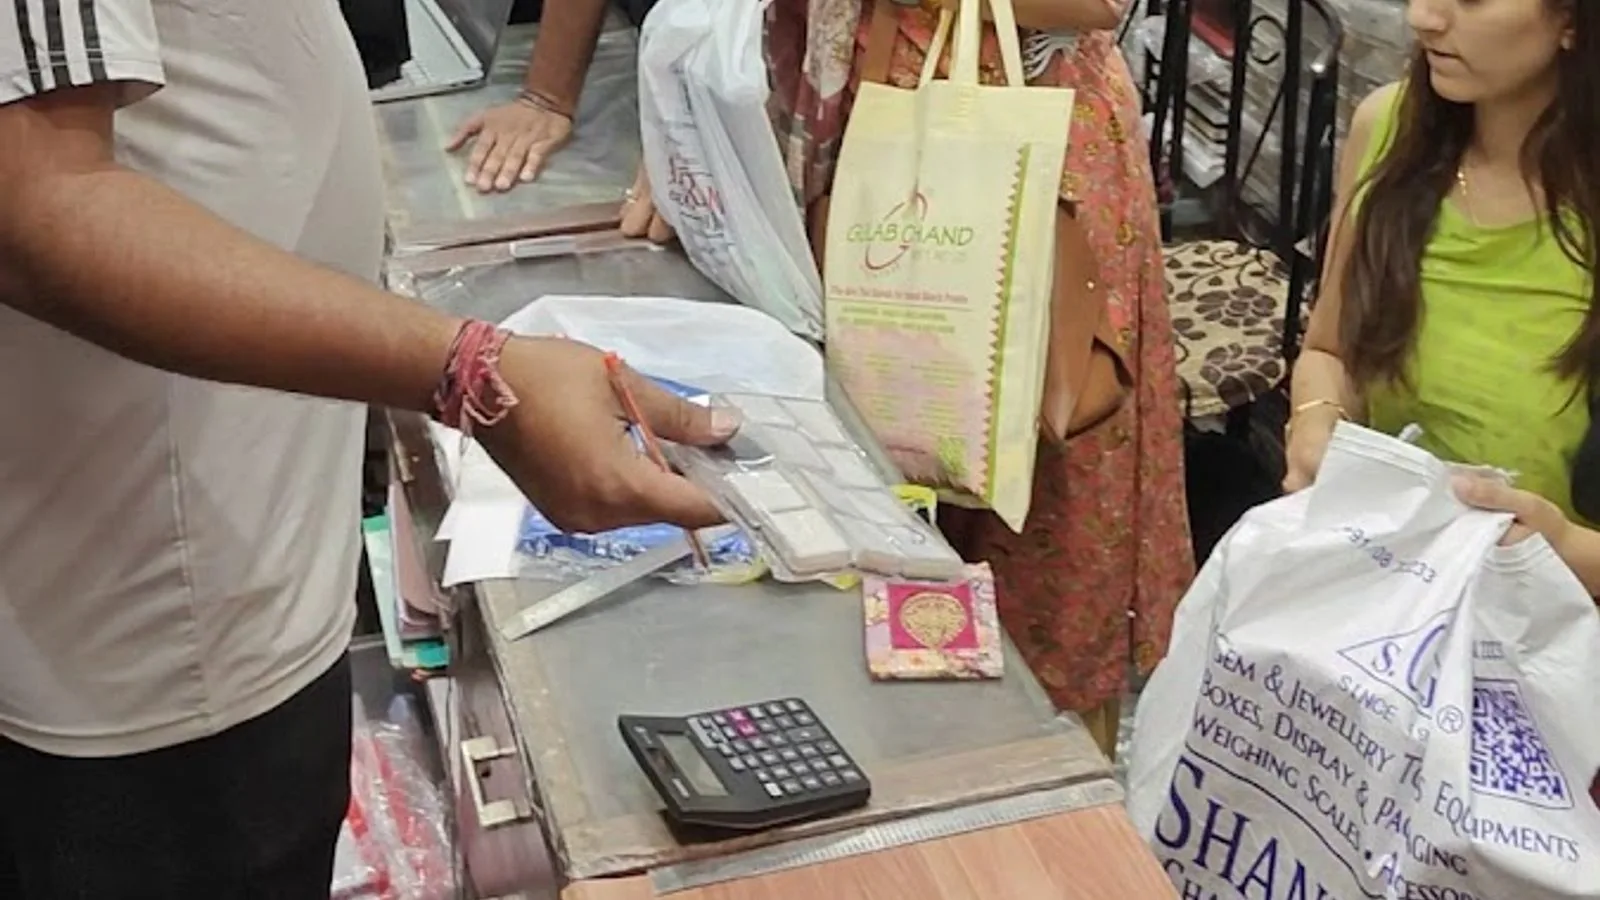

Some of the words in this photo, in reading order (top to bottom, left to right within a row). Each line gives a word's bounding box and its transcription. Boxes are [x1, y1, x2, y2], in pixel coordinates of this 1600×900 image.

[1285, 679, 1396, 773] JEWELLERY
[1335, 674, 1399, 724] SINCE
[1193, 713, 1299, 789] WEIGHING
[1273, 711, 1355, 788] DISPLAY
